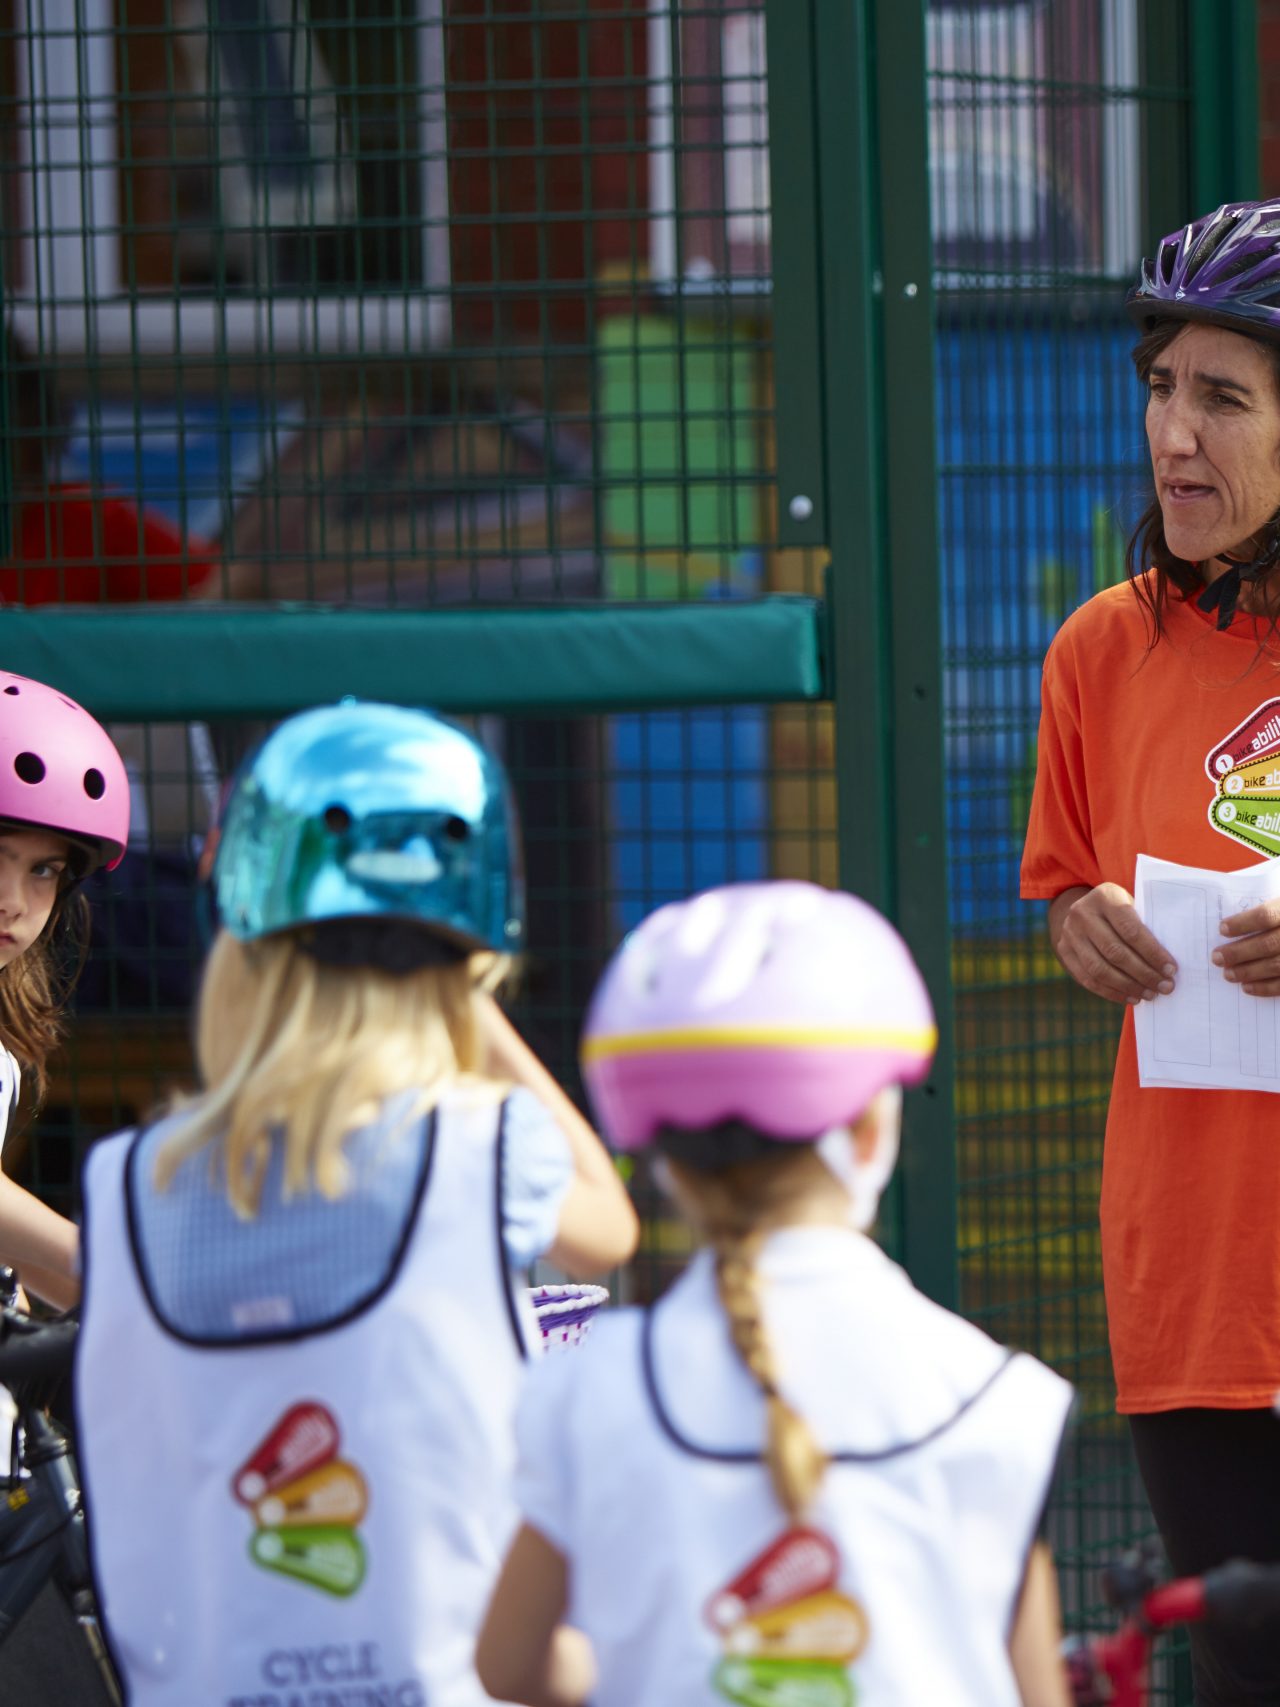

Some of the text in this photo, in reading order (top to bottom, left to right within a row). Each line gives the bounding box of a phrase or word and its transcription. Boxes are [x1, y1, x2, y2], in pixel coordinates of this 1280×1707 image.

[1230, 779, 1239, 790] 2
[1223, 806, 1232, 818] 3
[261, 1642, 382, 1688] CYCLE
